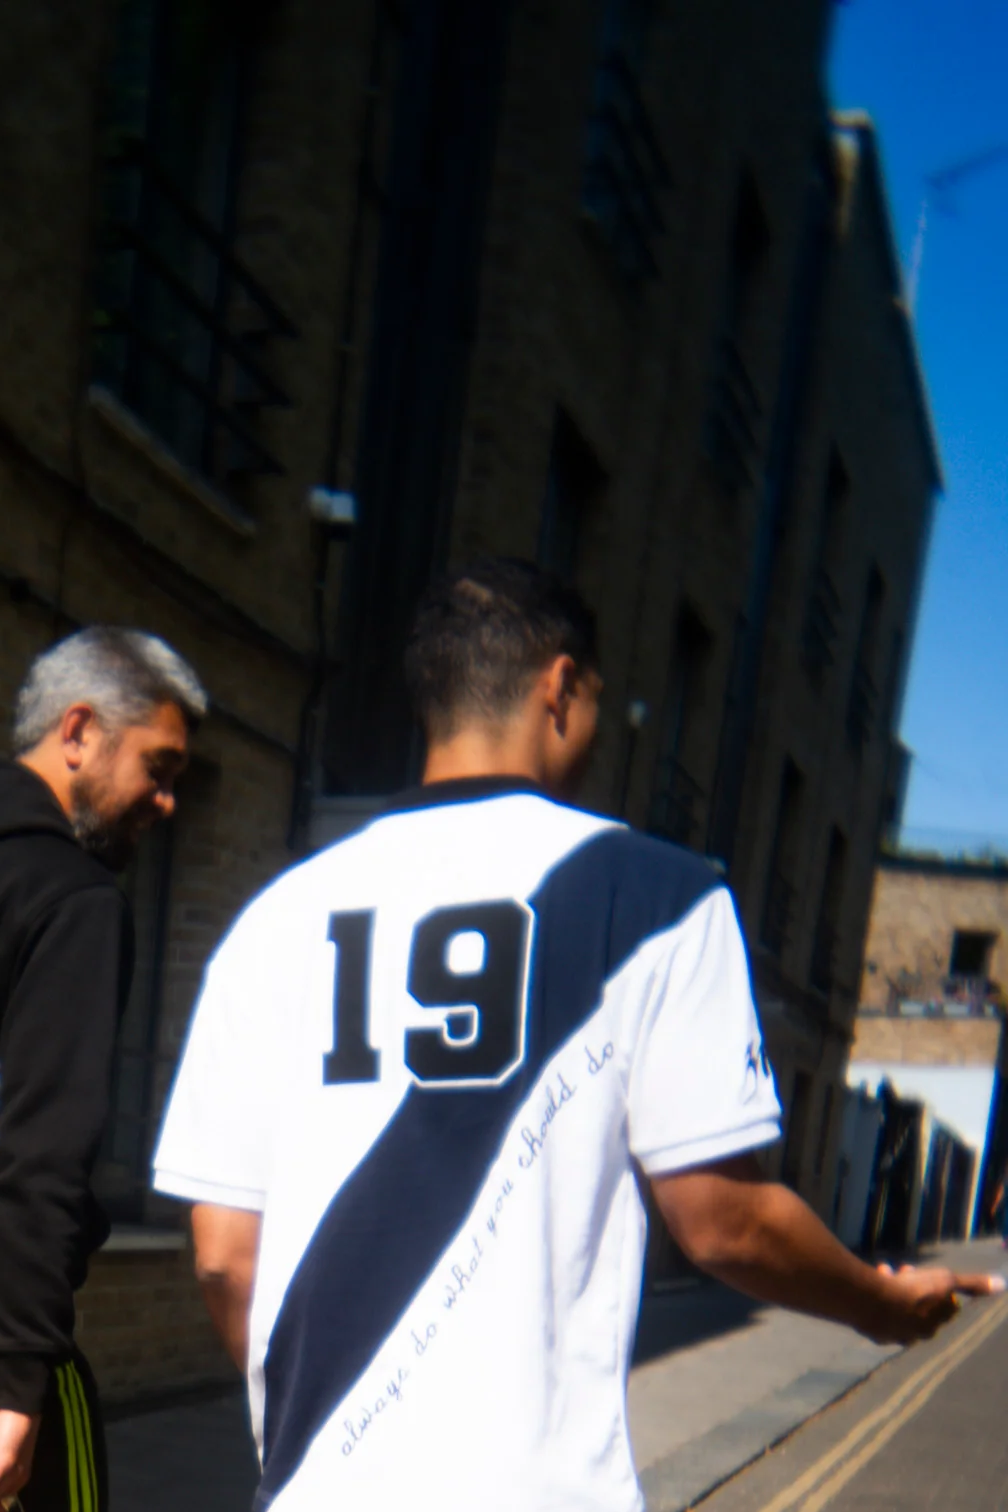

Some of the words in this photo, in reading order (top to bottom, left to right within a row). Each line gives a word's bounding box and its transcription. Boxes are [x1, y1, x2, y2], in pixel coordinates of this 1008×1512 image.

[321, 897, 534, 1087] 19
[342, 1367, 409, 1456] always
[411, 1321, 437, 1356] do
[444, 1235, 483, 1309] what
[486, 1178, 514, 1238] you
[518, 1071, 577, 1169] should
[584, 1041, 614, 1075] do
